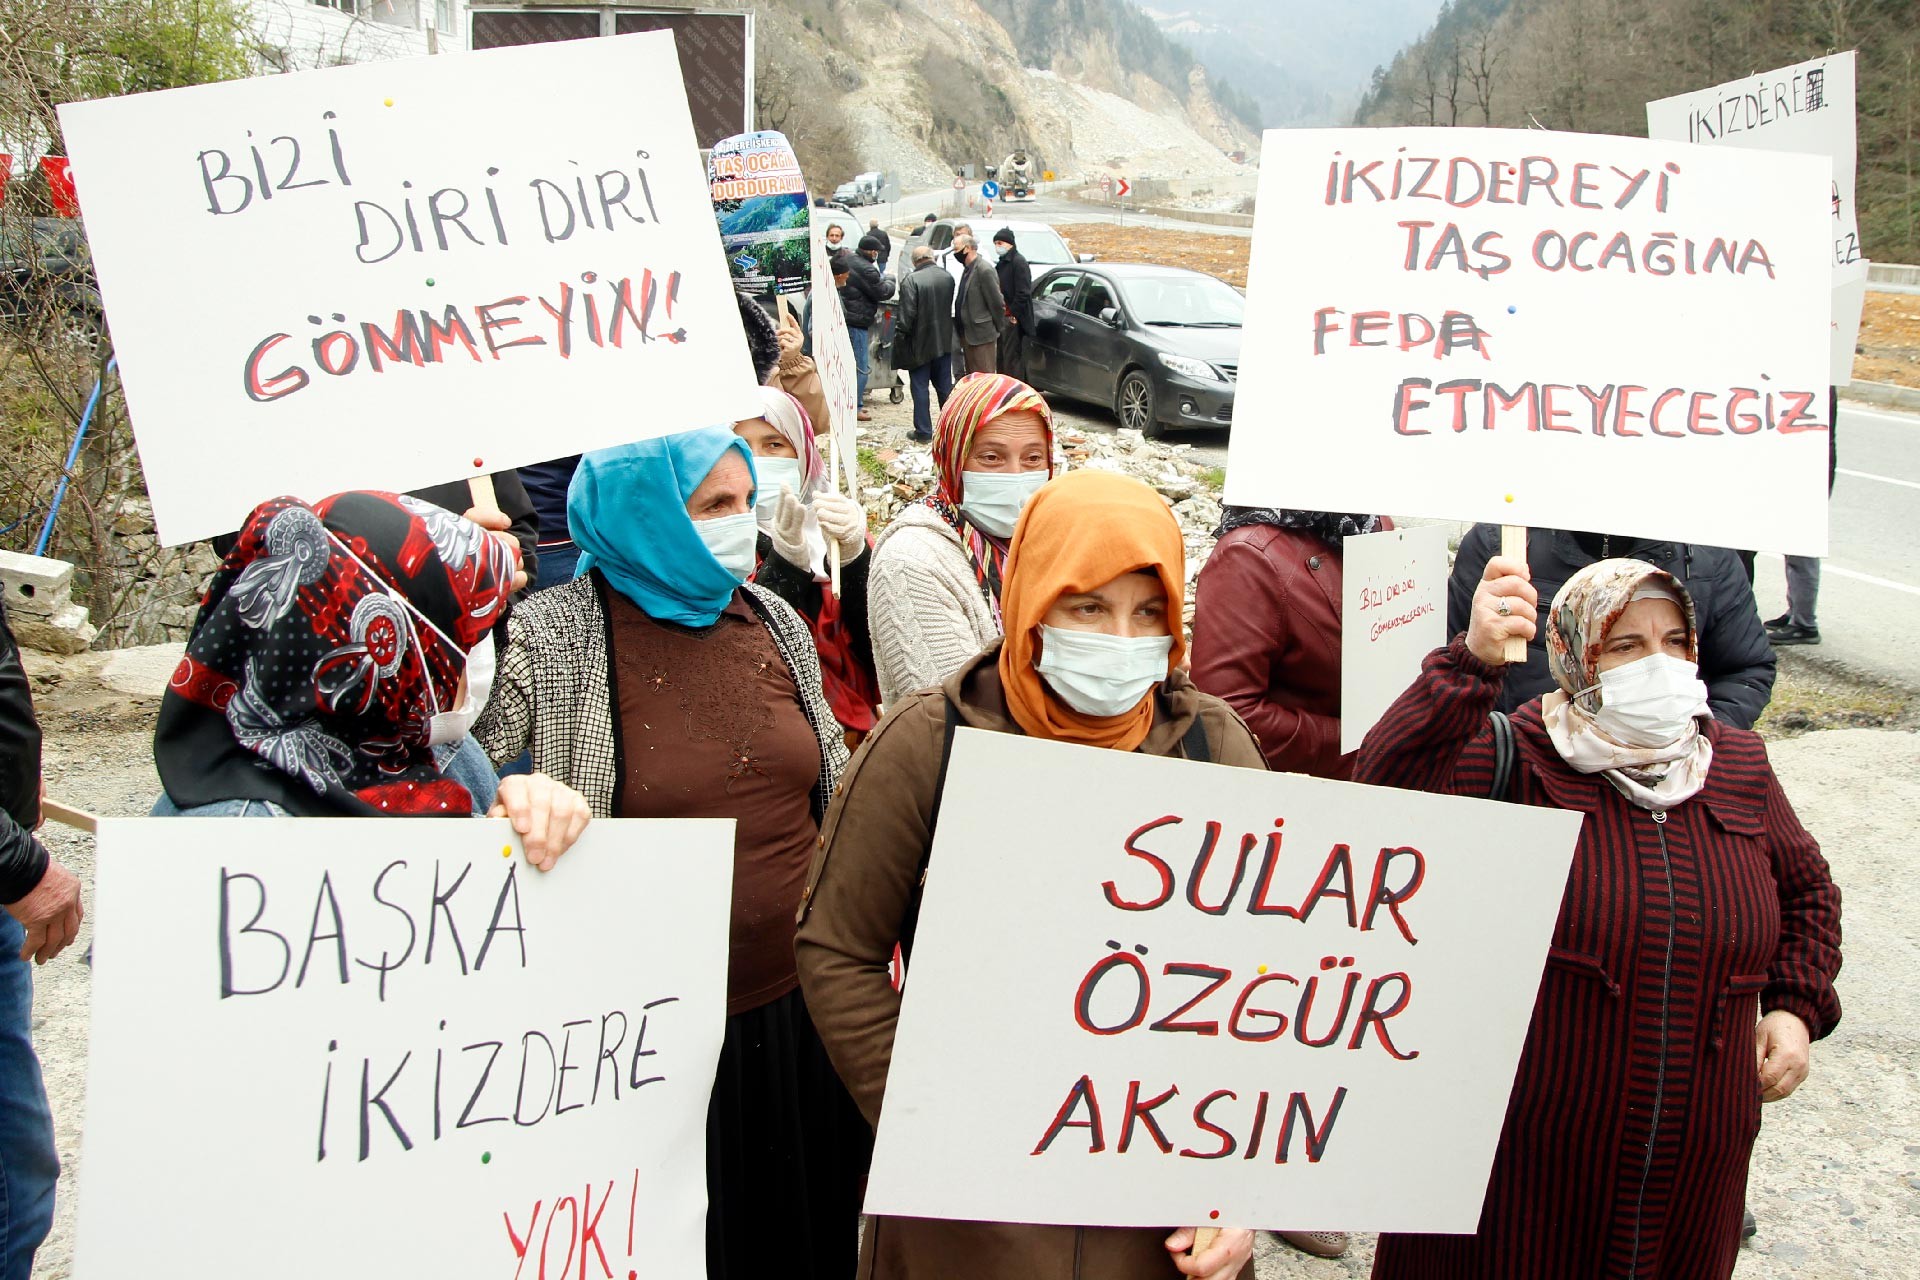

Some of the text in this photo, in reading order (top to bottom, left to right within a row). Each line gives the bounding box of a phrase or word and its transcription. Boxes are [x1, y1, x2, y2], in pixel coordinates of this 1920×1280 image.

[197, 110, 351, 215] BİZİ
[355, 149, 661, 264] DİRİ DİRİ
[715, 157, 743, 177] TAŞ
[1324, 146, 1681, 213] İKİZDEREYİ
[1398, 220, 1512, 281] TAŞ
[1532, 231, 1777, 280] OCAĞINA
[1313, 306, 1491, 361] FEDA
[219, 858, 526, 1001] BAŞKA
[1074, 939, 1419, 1060] ÖZGÜR
[316, 996, 680, 1163] İKİZDERE
[1030, 1074, 1347, 1165] AKSIN
[503, 1167, 639, 1280] YOK!
